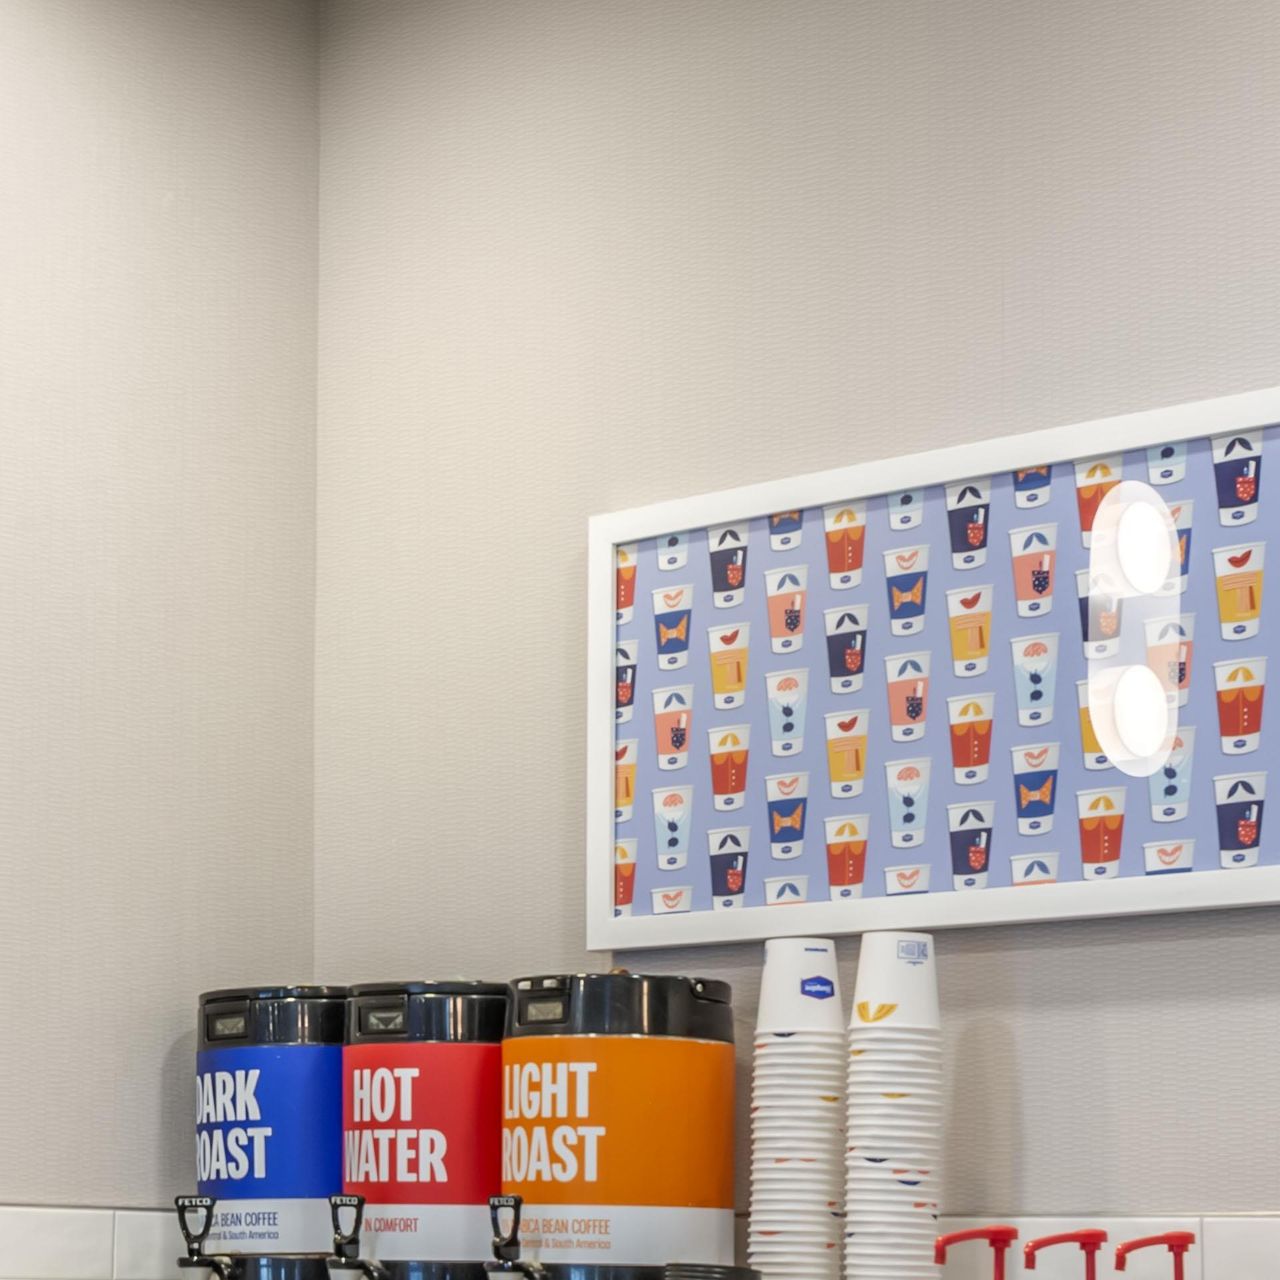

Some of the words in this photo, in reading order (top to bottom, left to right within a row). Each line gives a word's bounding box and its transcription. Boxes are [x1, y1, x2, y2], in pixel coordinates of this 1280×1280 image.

[353, 1067, 420, 1122] HOT
[504, 1062, 597, 1120] LIGHT
[344, 1128, 448, 1183] WATER
[502, 1125, 606, 1182] ROAST
[178, 1197, 211, 1206] FETCO
[221, 1212, 242, 1227] BEAN
[244, 1211, 278, 1227] COFFEE
[374, 1217, 419, 1233] COMFORT
[542, 1218, 568, 1234] BEAN
[572, 1218, 611, 1235] COFFEE
[249, 1230, 279, 1240] America
[576, 1239, 611, 1249] America
